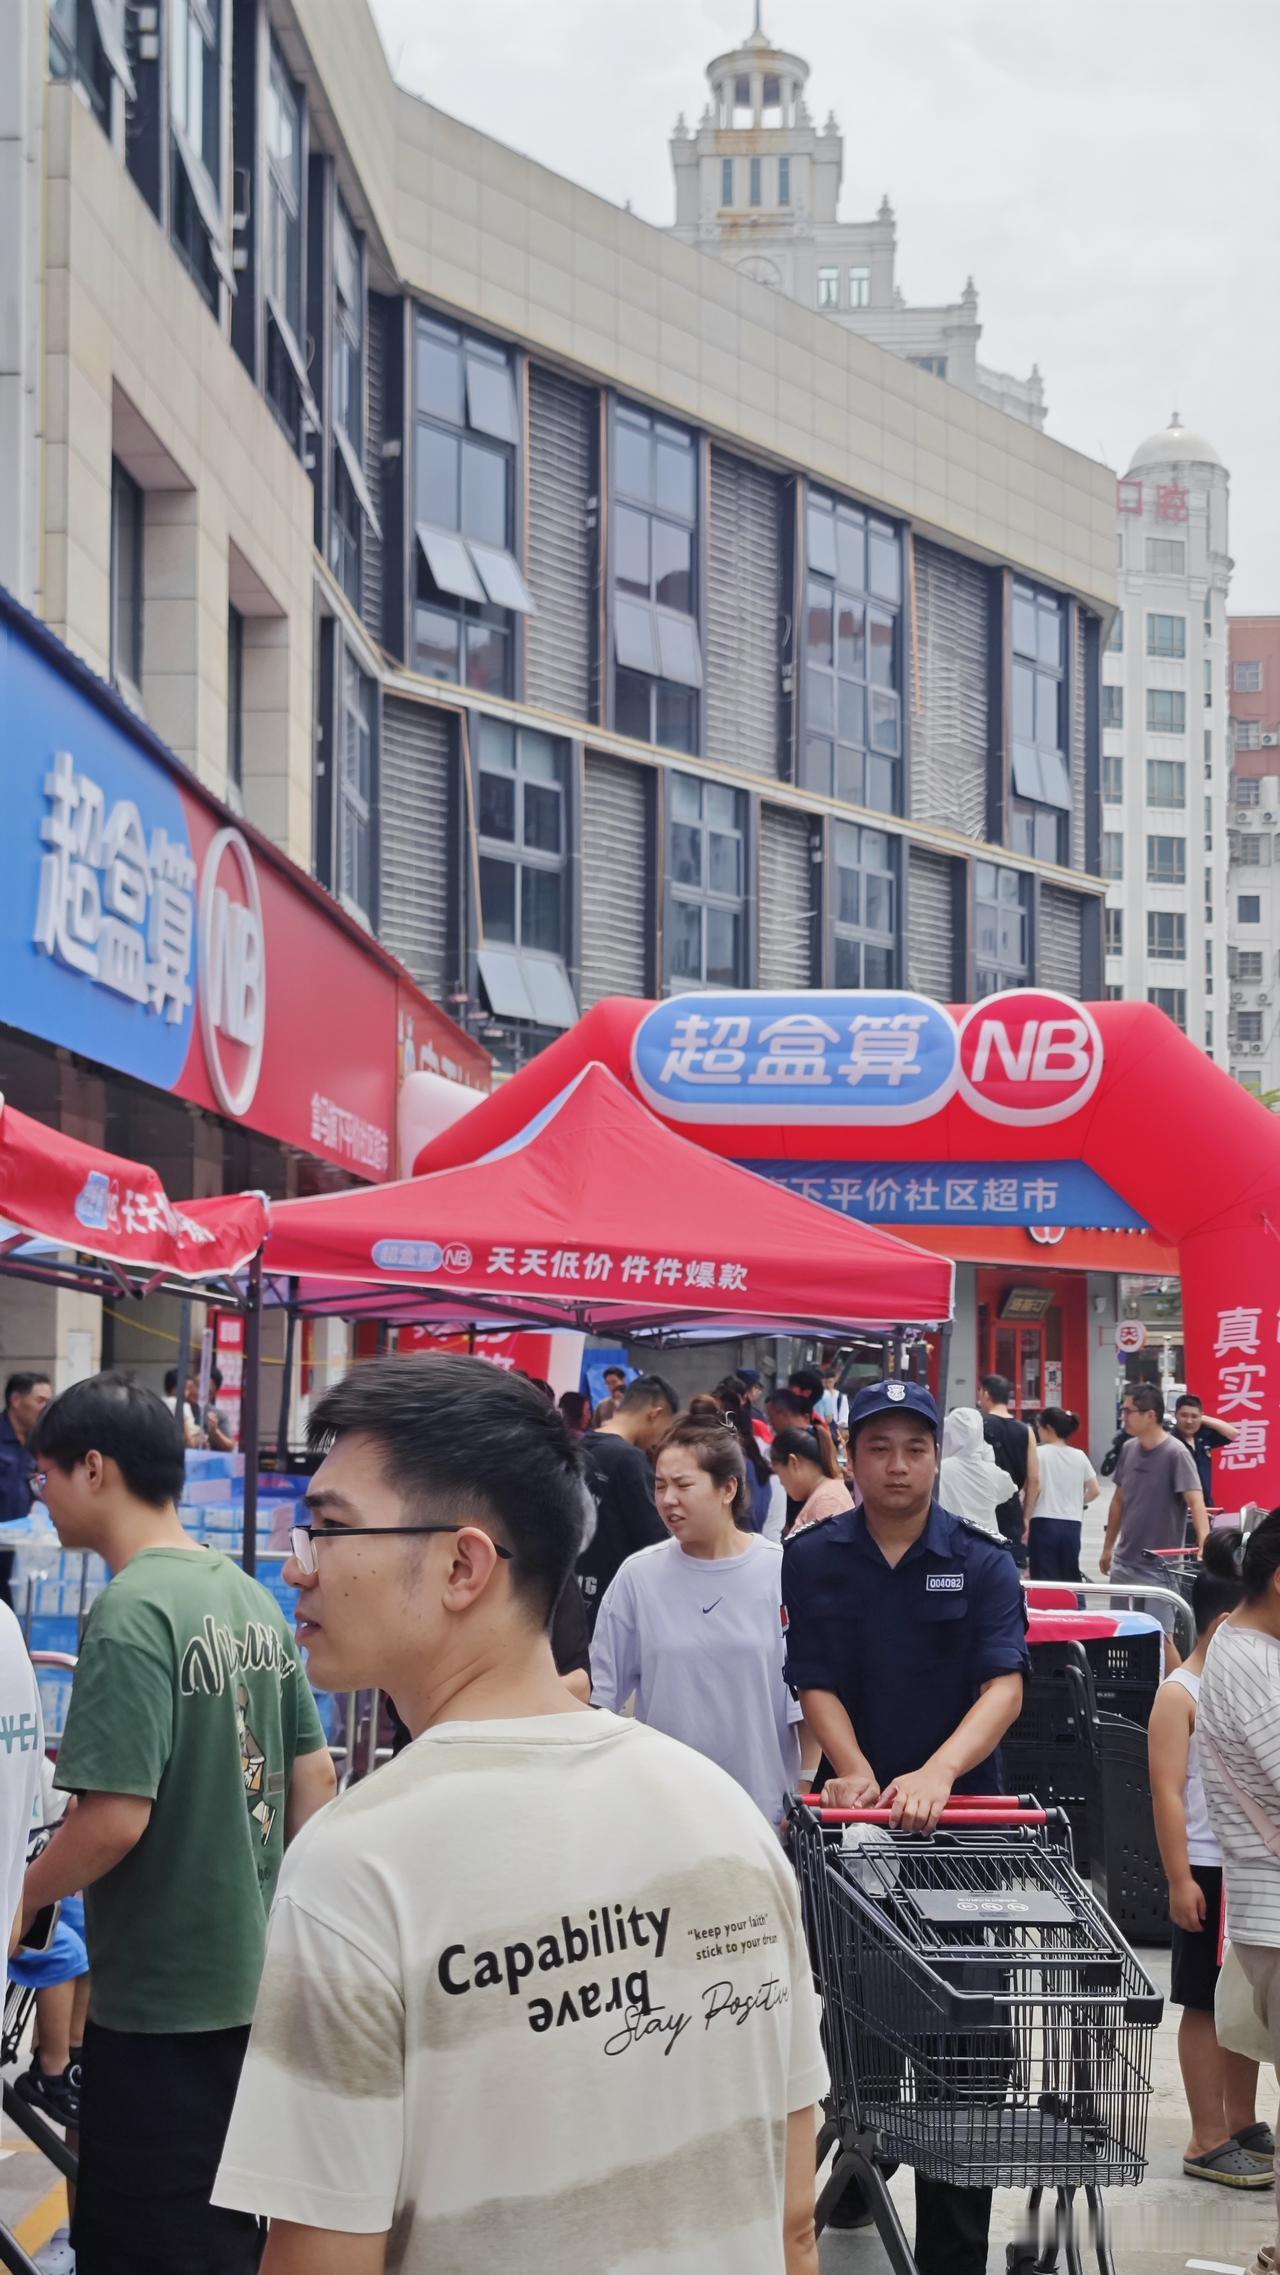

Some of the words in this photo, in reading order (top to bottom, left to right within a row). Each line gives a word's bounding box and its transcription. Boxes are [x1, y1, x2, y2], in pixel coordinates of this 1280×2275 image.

[34, 751, 196, 1024] 超盒算
[211, 887, 264, 1047] NB
[660, 1013, 929, 1086] 超盒算
[971, 1018, 1091, 1082] NB
[769, 1177, 1058, 1213] 下平价社区超市
[445, 1249, 470, 1268] NB
[486, 1246, 613, 1281] 天天低价
[620, 1255, 749, 1292] 件件爆款
[1212, 1306, 1269, 1470] 真实惠
[930, 1578, 961, 1588] 004082
[438, 1904, 671, 1996] Capability
[696, 1943, 723, 1960] stick
[726, 1943, 738, 1954] to
[740, 1937, 761, 1954] your
[724, 1920, 747, 1937] your
[528, 1969, 652, 2033] brave
[603, 2004, 693, 2057] Stay
